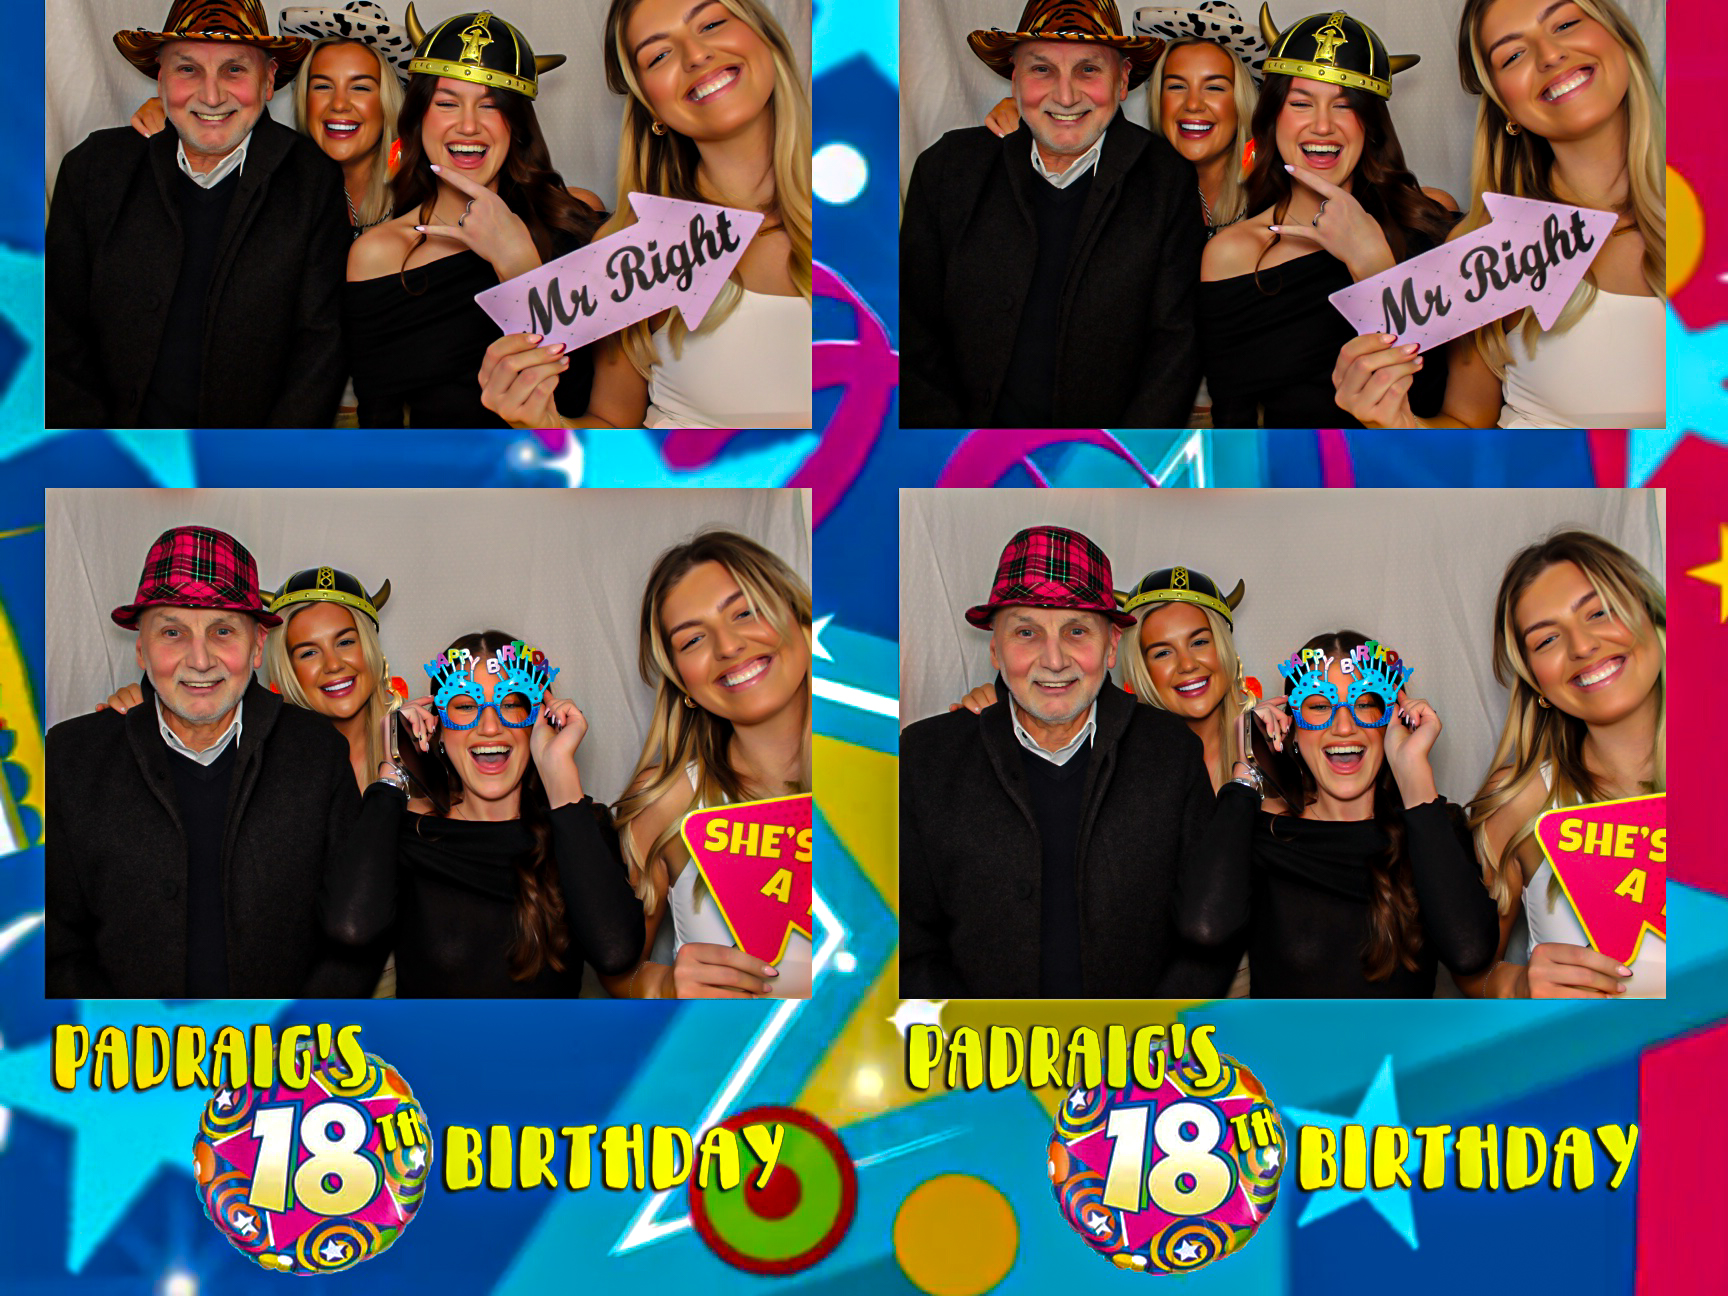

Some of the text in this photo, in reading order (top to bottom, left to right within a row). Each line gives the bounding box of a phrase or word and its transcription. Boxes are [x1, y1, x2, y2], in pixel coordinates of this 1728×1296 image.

[523, 210, 740, 335] Mr Right
[1377, 210, 1594, 335] Mr Right
[760, 868, 793, 903] A
[1614, 868, 1647, 903] A
